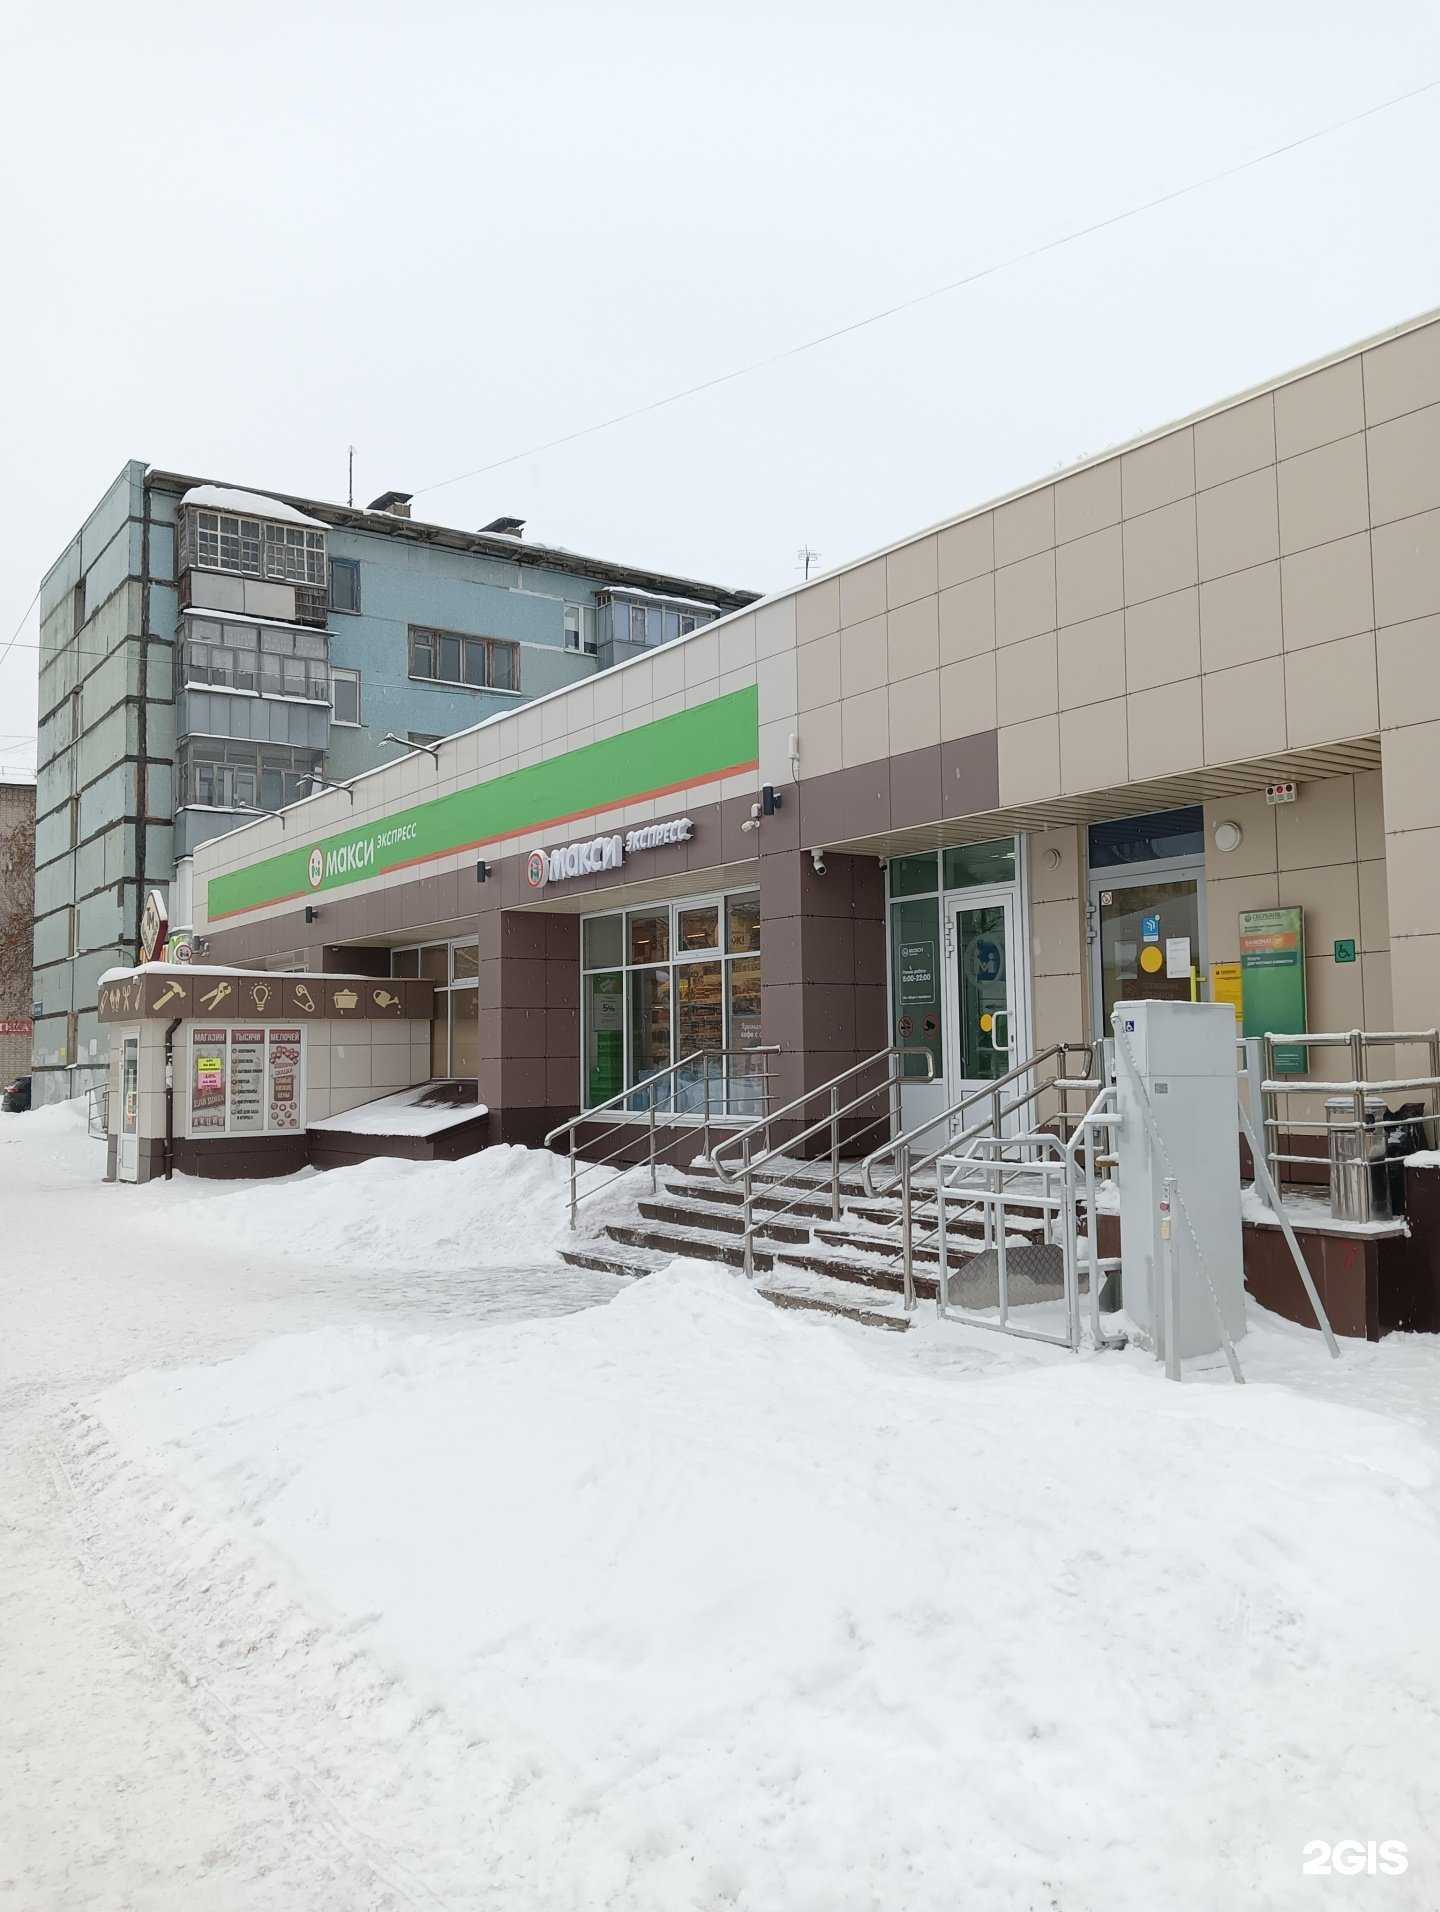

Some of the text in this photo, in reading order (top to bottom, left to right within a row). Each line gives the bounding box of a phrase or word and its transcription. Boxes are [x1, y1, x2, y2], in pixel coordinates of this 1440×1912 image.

[376, 822, 417, 848] ЭКСПРЕСС
[194, 1032, 225, 1041] МАГАЗИН
[270, 1031, 300, 1041] МЕЛОЧЕЙ
